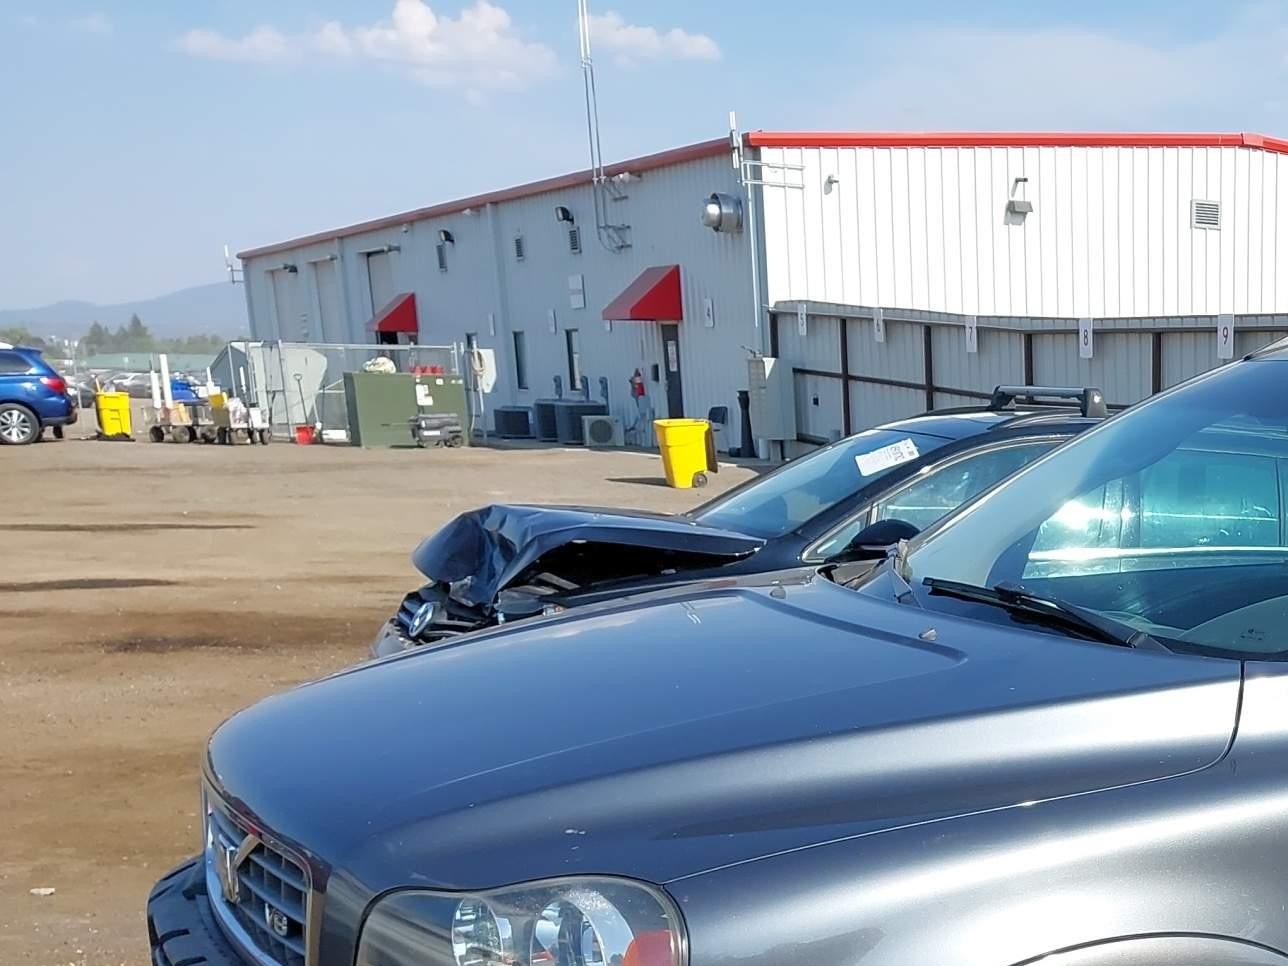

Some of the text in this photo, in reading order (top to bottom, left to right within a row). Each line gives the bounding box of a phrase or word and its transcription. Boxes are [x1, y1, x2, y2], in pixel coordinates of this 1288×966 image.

[968, 326, 973, 342] 7
[1083, 329, 1089, 346] 8
[1222, 326, 1229, 345] 9
[264, 902, 288, 937] V8
